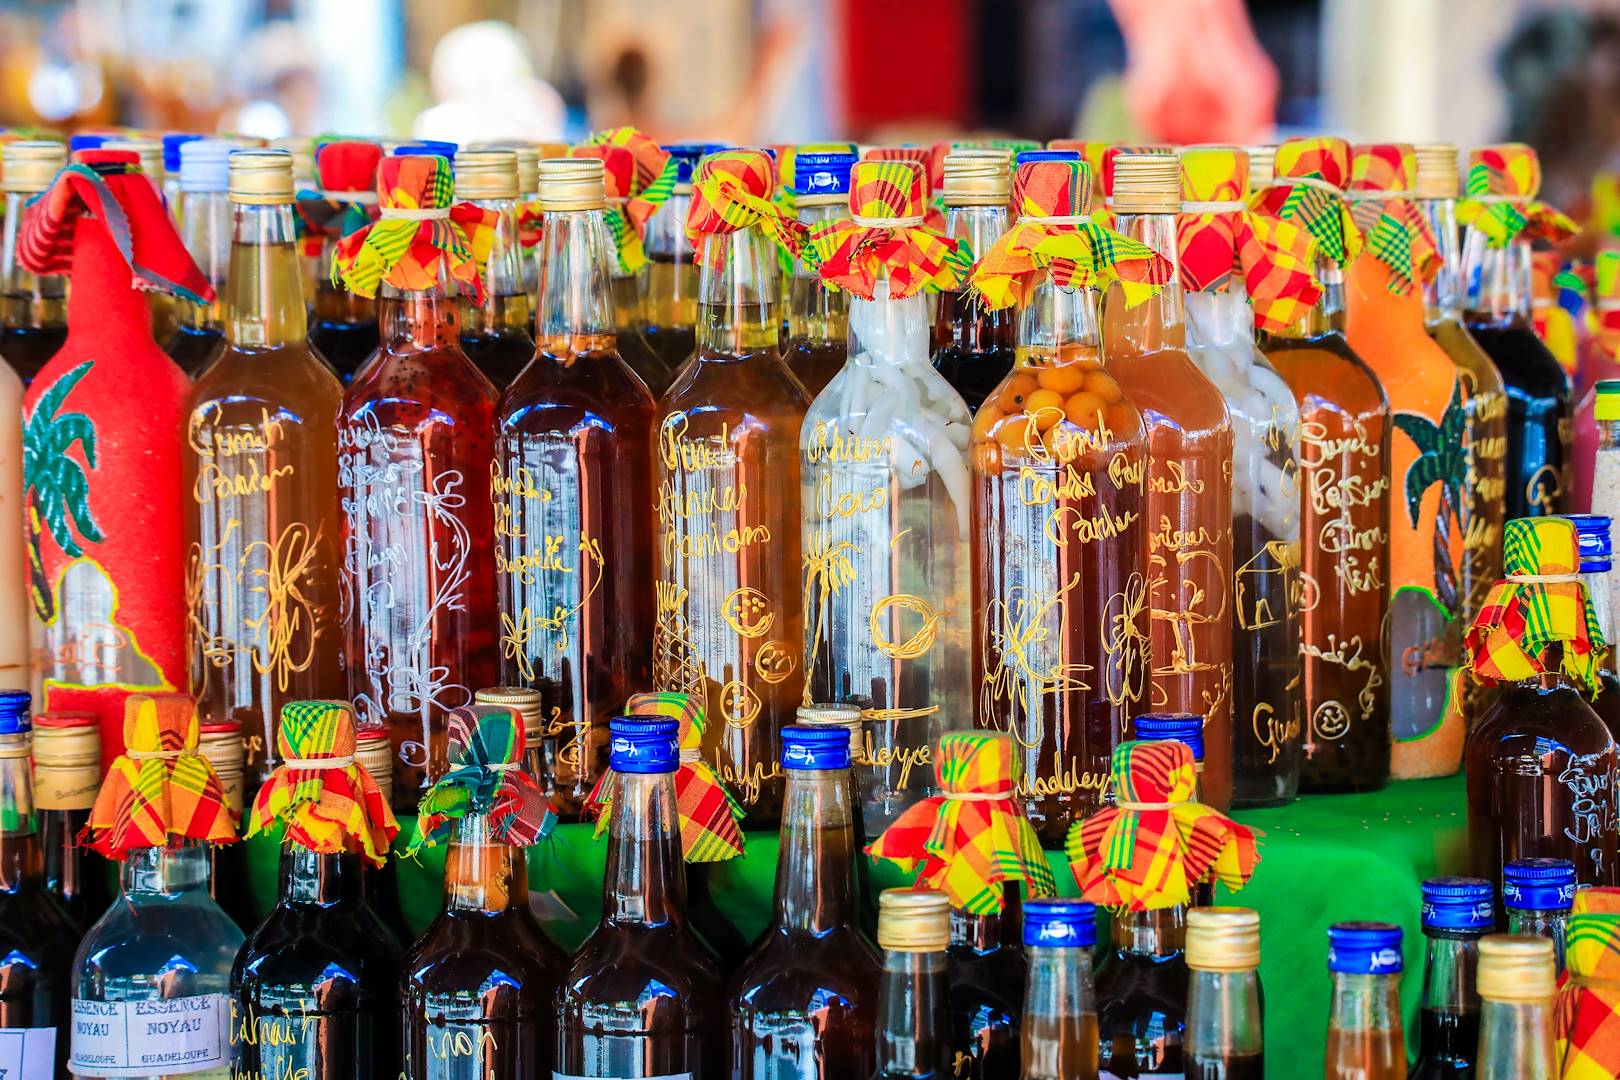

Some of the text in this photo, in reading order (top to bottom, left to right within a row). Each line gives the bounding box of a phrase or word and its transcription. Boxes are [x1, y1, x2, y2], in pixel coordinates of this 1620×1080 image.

[816, 474, 888, 519] Coco
[136, 996, 212, 1016] ESSENCE
[147, 1018, 202, 1036] NOYAU
[141, 1048, 209, 1064] GUADELOUPE
